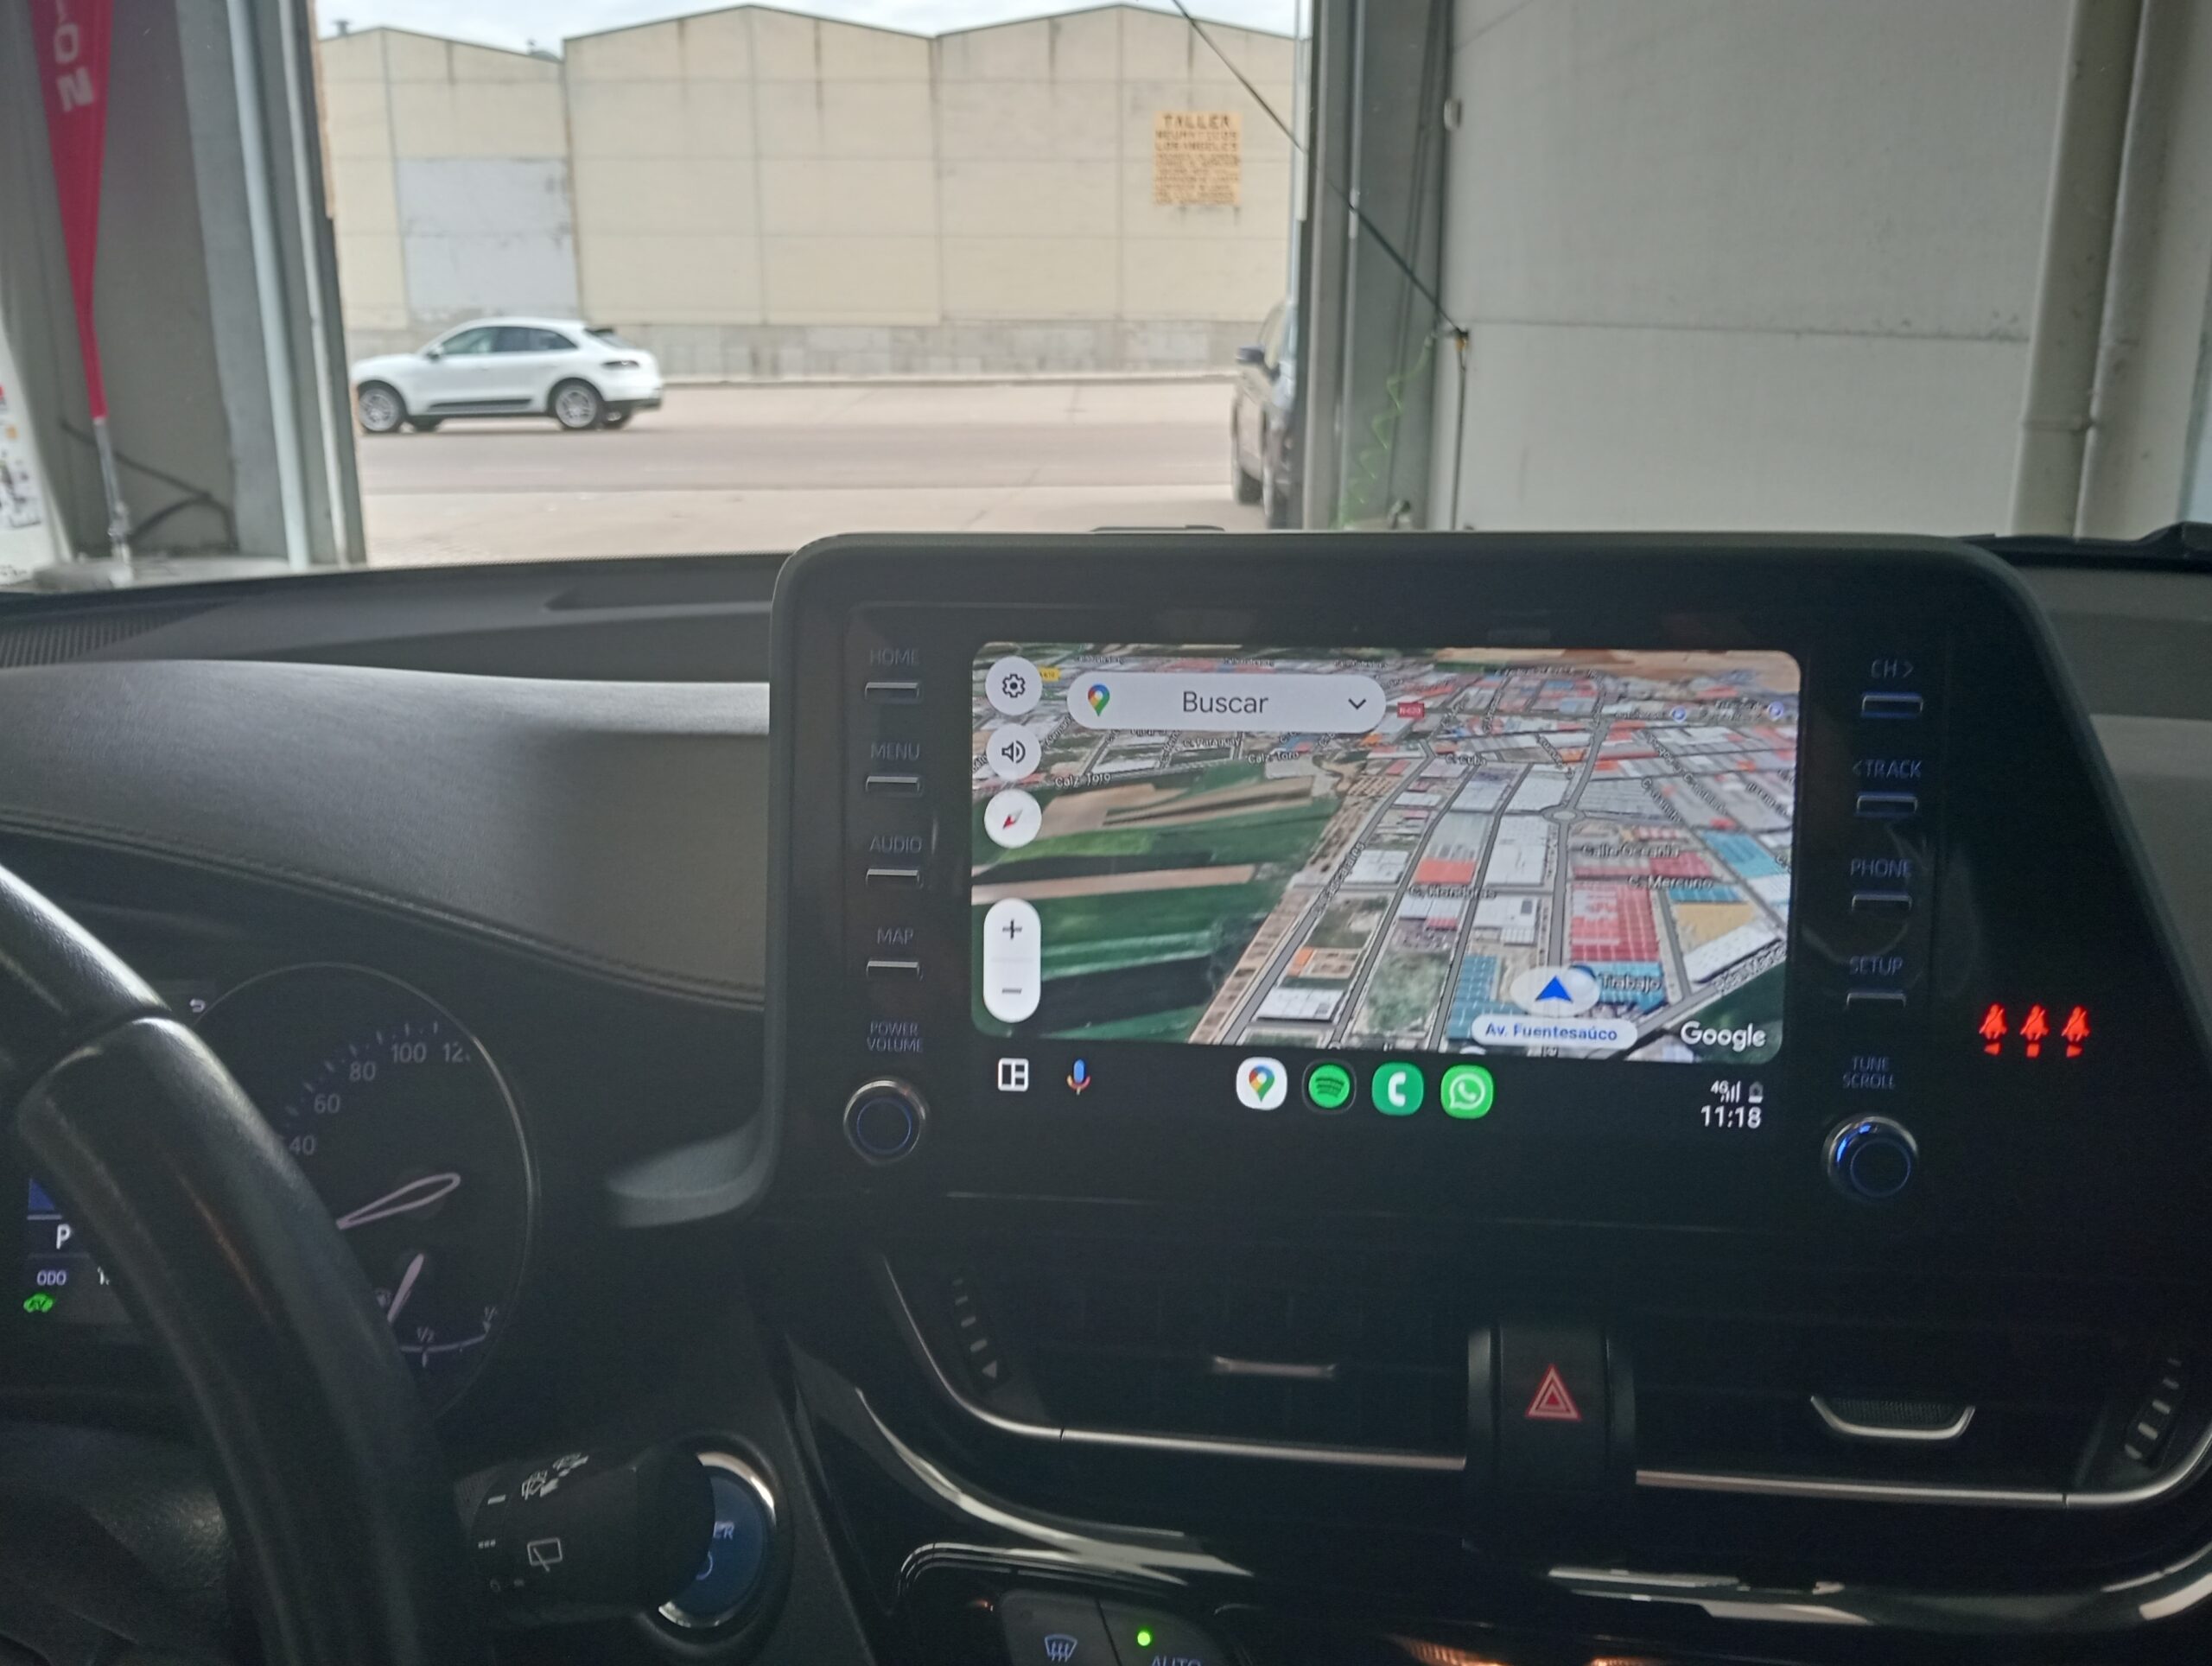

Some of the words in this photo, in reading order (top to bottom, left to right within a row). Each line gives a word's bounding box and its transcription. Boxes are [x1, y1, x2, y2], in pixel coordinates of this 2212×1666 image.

[870, 650, 919, 666] HOME
[1182, 690, 1269, 714] Buscar
[871, 743, 920, 760] MENU
[870, 836, 922, 854] AUDIO
[1850, 859, 1912, 879] PHONE
[876, 927, 914, 944] MAP
[1849, 957, 1904, 976] SETUP
[1602, 974, 1662, 994] Trabajo
[870, 1021, 918, 1037] POWER
[1484, 1021, 1508, 1037] Av.
[1513, 1021, 1618, 1041] Fuentesaúco
[1681, 1021, 1766, 1052] Google
[391, 1041, 428, 1064] 100
[867, 1037, 925, 1053] VOLUME
[348, 1060, 377, 1082] 80
[1852, 1057, 1890, 1072] TUNE
[1842, 1073, 1895, 1091] SCROLL
[314, 1093, 341, 1115] 60
[1700, 1104, 1763, 1129] 11:18
[289, 1135, 316, 1156] 40
[55, 1223, 72, 1250] P
[36, 1269, 67, 1287] ODO
